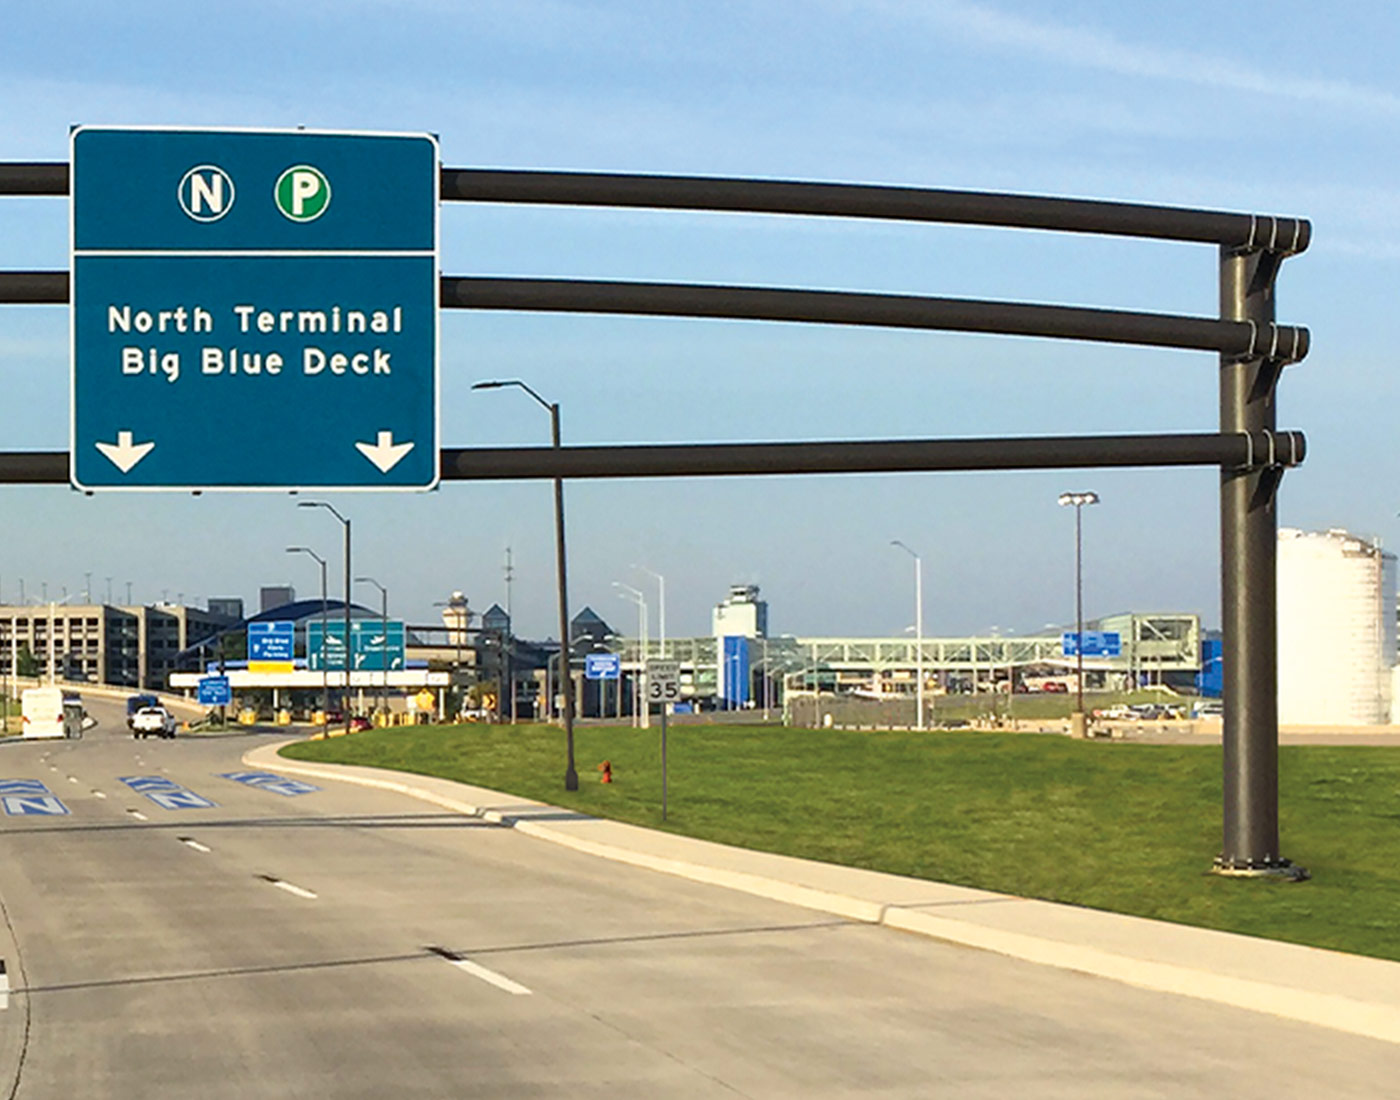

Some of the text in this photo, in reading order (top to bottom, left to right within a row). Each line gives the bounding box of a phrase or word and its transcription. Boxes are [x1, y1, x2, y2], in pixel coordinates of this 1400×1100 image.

[190, 172, 321, 216] N P
[108, 305, 402, 333] North Terminal
[122, 347, 392, 382] Big Blue Deck
[650, 682, 678, 699] 35
[3, 797, 66, 815] N
